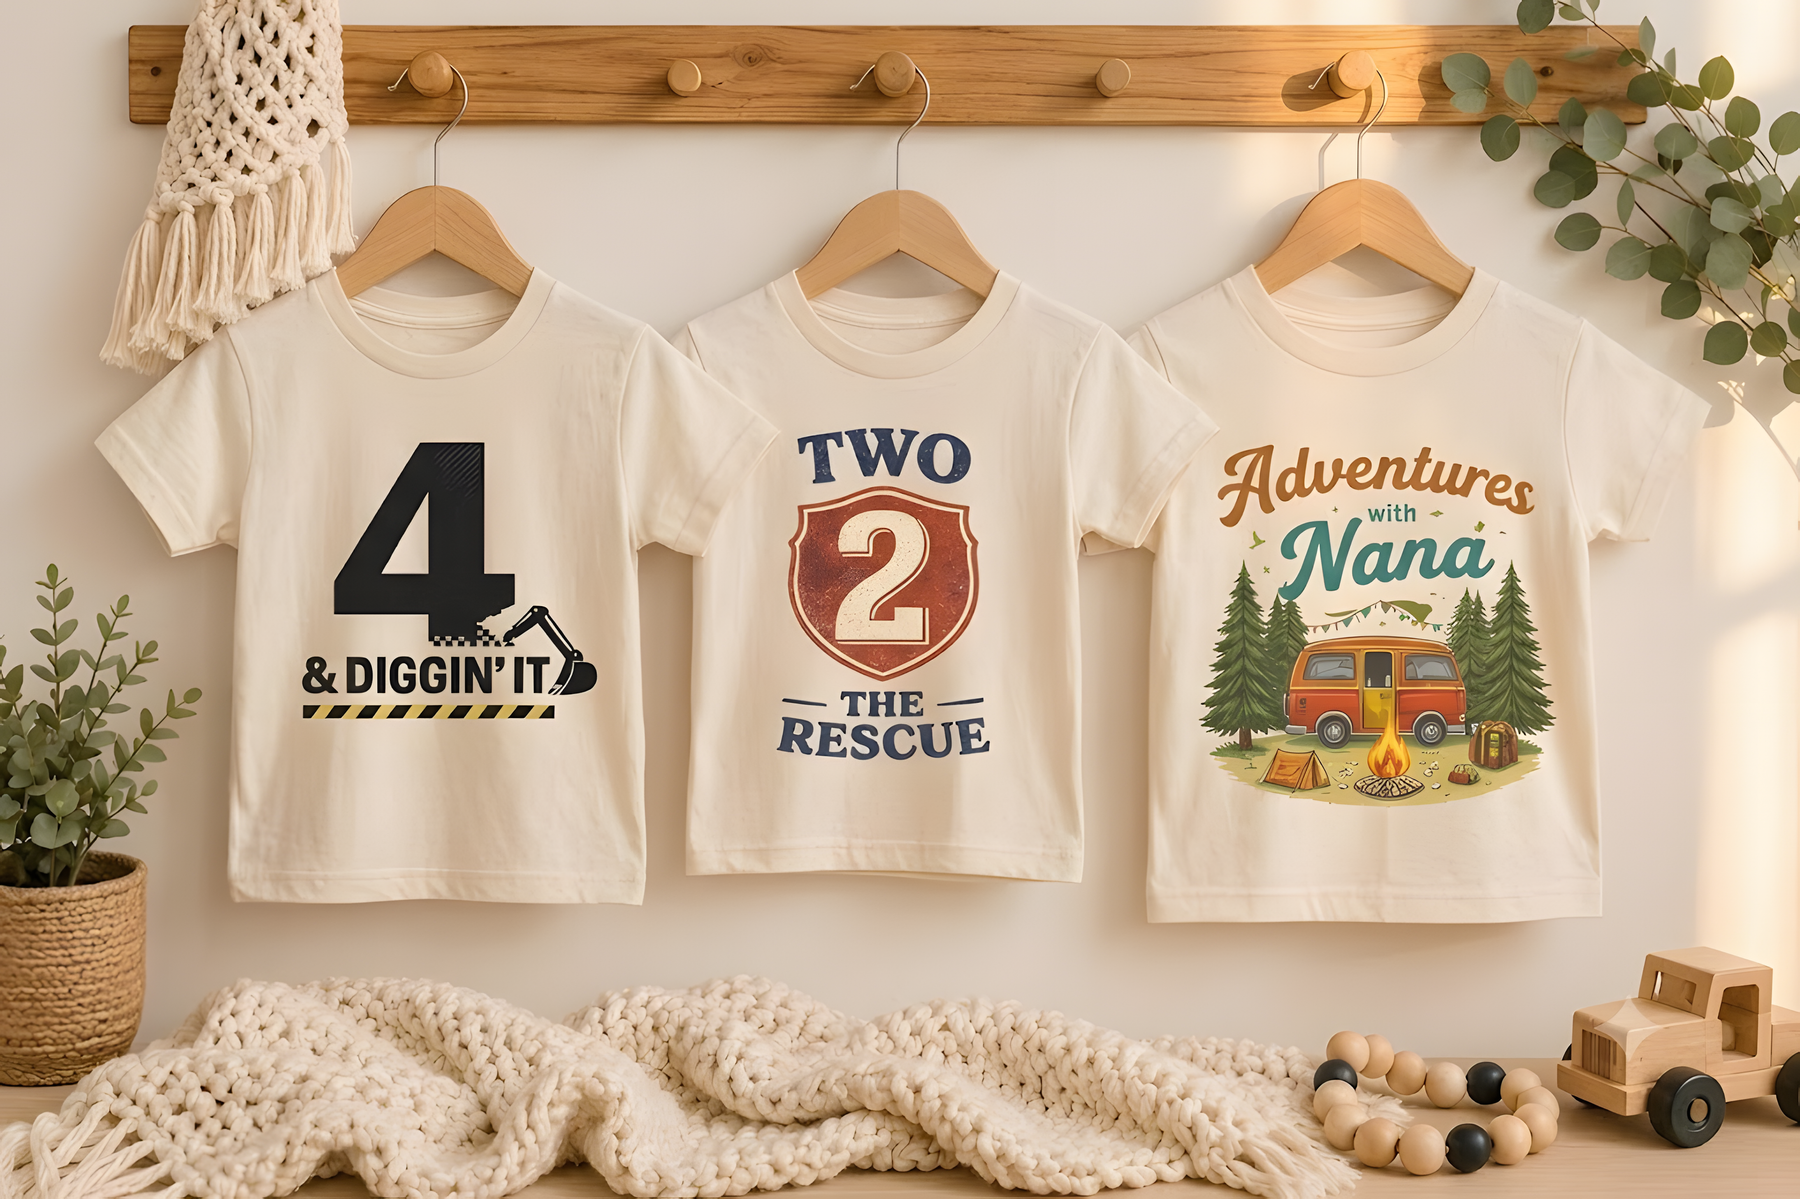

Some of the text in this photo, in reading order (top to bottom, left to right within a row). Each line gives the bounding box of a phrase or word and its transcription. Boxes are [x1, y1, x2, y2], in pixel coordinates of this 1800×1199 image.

[797, 428, 972, 484] TWO
[1217, 444, 1536, 528] Adventures
[1367, 503, 1416, 523] with
[333, 442, 516, 647] 4
[1277, 516, 1496, 601] Nana
[835, 509, 930, 645] 2
[301, 655, 339, 694] &
[514, 656, 550, 693] IT
[840, 691, 924, 717] THE
[776, 716, 991, 760] RESCUE
